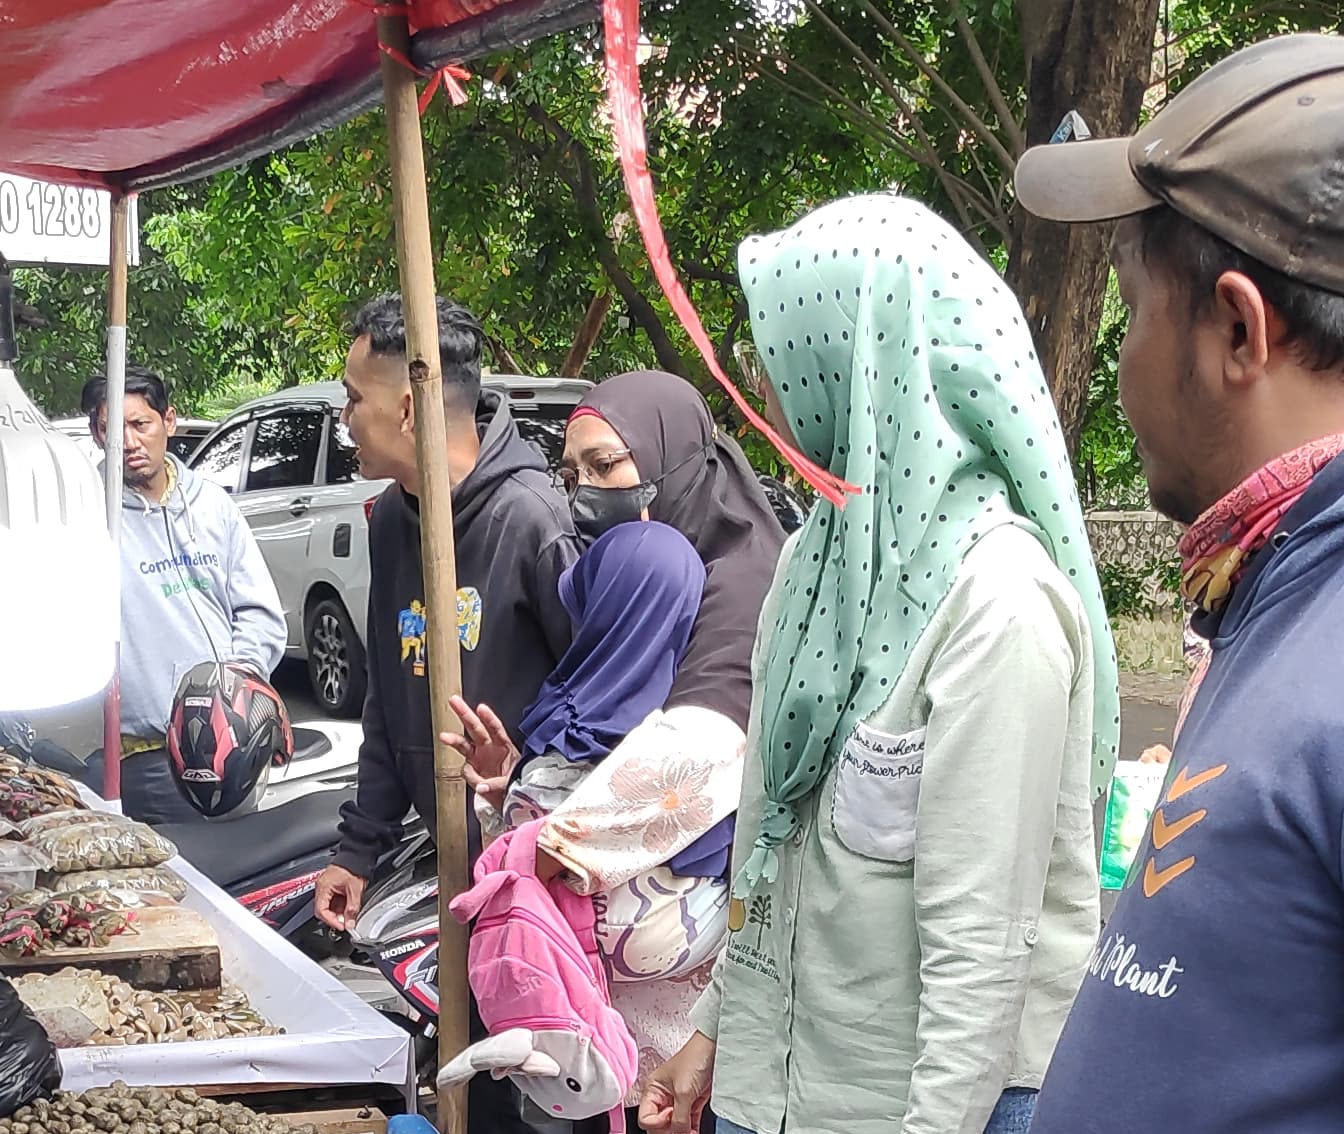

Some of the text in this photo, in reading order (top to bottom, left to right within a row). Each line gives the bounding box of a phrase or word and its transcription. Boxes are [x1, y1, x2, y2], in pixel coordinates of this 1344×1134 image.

[26, 181, 101, 238] 1288
[887, 738, 925, 756] where
[379, 938, 426, 961] HONDA
